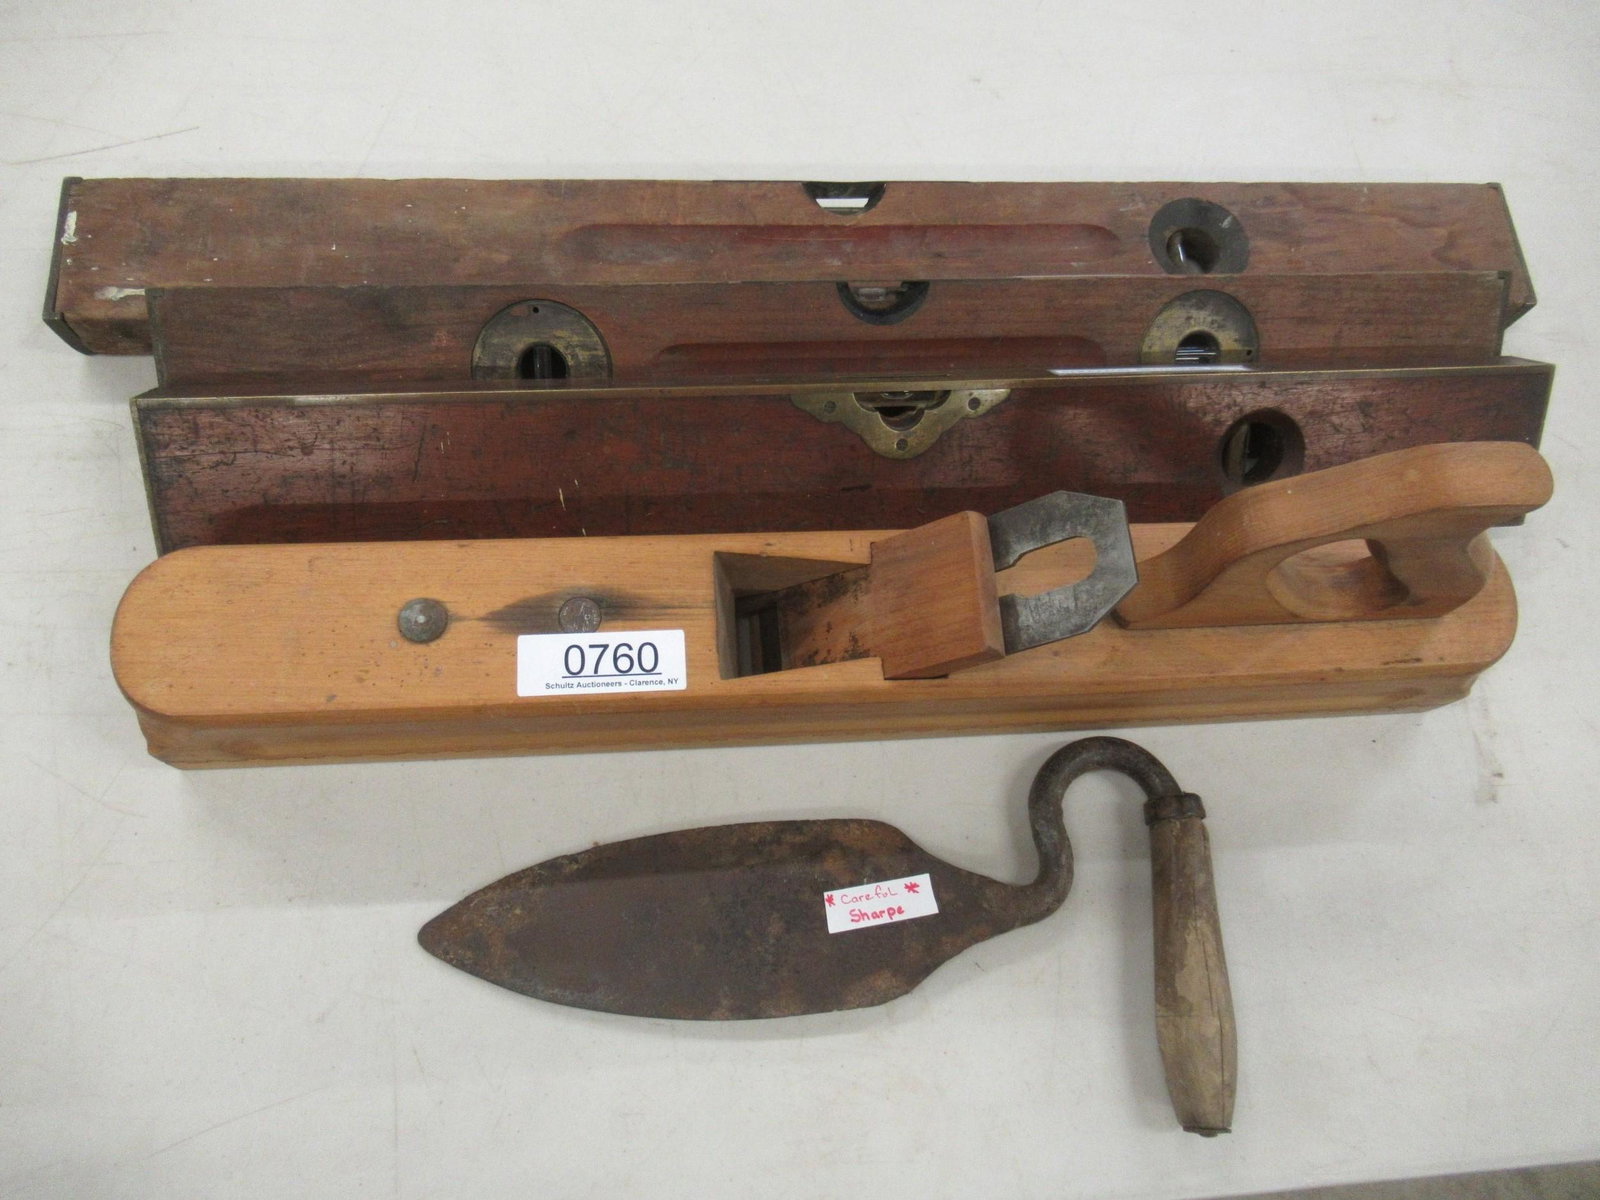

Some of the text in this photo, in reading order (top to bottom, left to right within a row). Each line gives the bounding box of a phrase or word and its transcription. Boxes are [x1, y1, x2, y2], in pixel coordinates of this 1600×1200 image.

[564, 642, 659, 676] 0760
[545, 682, 574, 690] Schultz
[576, 681, 622, 689] Auctioneers
[629, 679, 666, 687] Clarence,
[849, 905, 905, 923] Sharpe
